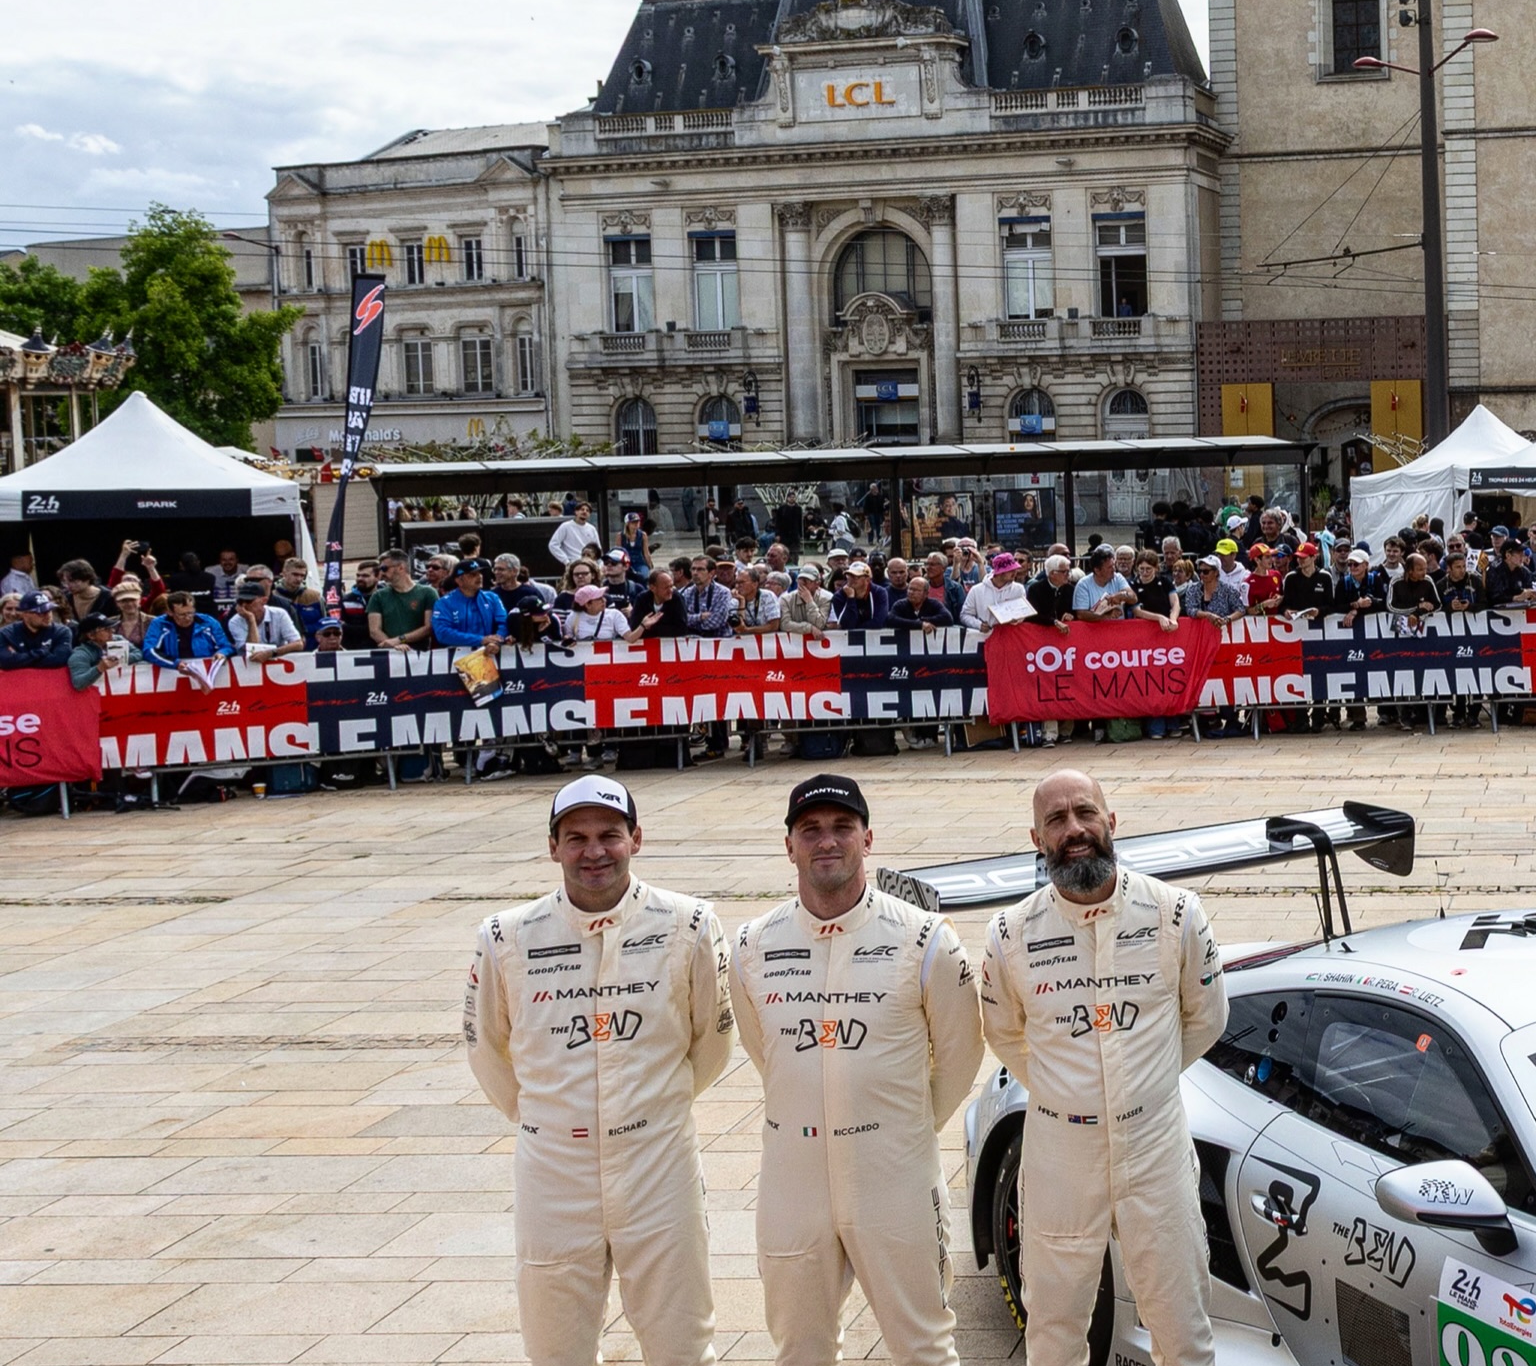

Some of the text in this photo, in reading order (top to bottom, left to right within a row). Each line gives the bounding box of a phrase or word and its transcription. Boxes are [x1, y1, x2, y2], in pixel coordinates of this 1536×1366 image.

[826, 81, 896, 108] LCL
[329, 428, 401, 442] Mcnald's
[28, 495, 60, 510] 24h
[1026, 646, 1185, 673] :Of course
[1037, 667, 1187, 702] LE MANS
[804, 786, 850, 799] MANTHEY
[1172, 892, 1187, 927] HRX
[1116, 927, 1160, 940] WEC
[622, 934, 668, 948] WEC
[1028, 937, 1074, 952] PORSCHE
[529, 945, 580, 958] PORSCHE
[766, 950, 809, 960] PORSCHE
[853, 946, 899, 957] WEC
[528, 962, 581, 975] GOODYEAR
[1029, 954, 1078, 969] GOODYEAR
[763, 967, 812, 979] GOODYEAR
[1323, 973, 1357, 983] SHAHIN
[1056, 972, 1156, 991] MANTHEY
[1374, 980, 1400, 992] PERA
[556, 980, 660, 1001] MANTHEY
[786, 991, 887, 1004] MANTHEY
[1418, 991, 1445, 1008] LIETZ
[1055, 1014, 1071, 1025] THE
[550, 1025, 570, 1035] THE
[780, 1027, 798, 1036] THE
[1037, 1105, 1059, 1119] HRX
[1116, 1105, 1144, 1122] YASSER
[608, 1119, 648, 1137] RICHARD
[833, 1122, 880, 1136] RICCARDO
[1426, 1184, 1474, 1206] KW
[1332, 1221, 1351, 1240] THE
[1451, 1268, 1482, 1300] 24h
[1448, 1290, 1459, 1299] LE
[1457, 1294, 1478, 1308] MANS
[1499, 1317, 1533, 1339] TotalEnergies
